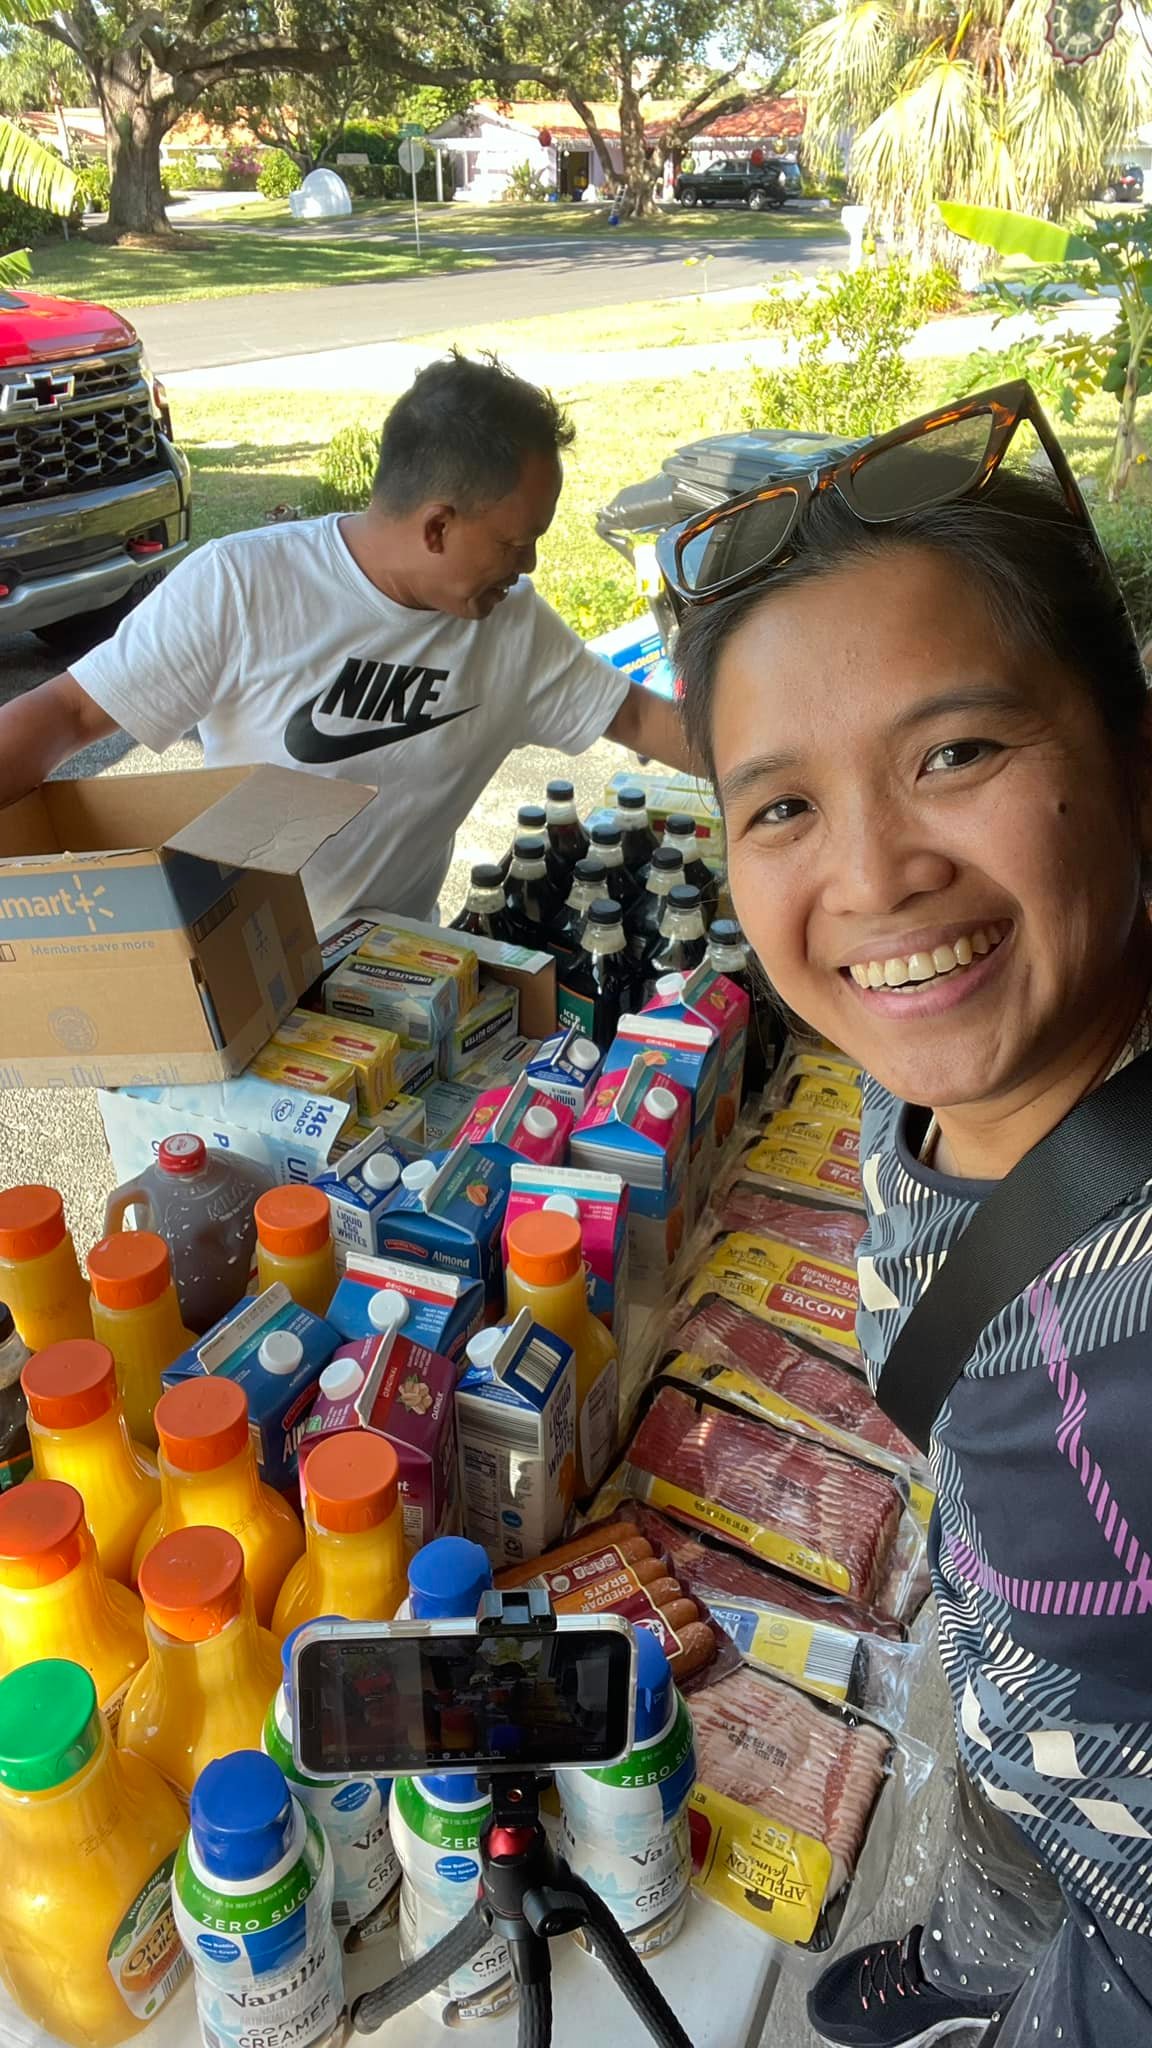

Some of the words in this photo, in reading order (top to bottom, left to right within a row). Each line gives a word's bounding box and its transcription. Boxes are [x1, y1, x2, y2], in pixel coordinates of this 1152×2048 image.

[318, 657, 451, 724] NIKE
[31, 942, 89, 955] Members
[92, 944, 119, 953] save
[122, 940, 155, 950] more
[354, 964, 388, 976] BUTTER
[388, 970, 432, 983] UNSALTED
[563, 1008, 581, 1022] ICED
[292, 1100, 318, 1135] LOADS
[305, 1104, 334, 1138] 146
[336, 1209, 363, 1229] LIQUID
[343, 1219, 359, 1236] EGG
[336, 1227, 367, 1248] WHITES
[431, 1250, 470, 1270] Almond
[800, 1265, 842, 1286] PREMIUM
[802, 1275, 859, 1302] BACON
[781, 1291, 847, 1320] BACON
[383, 1366, 398, 1398] ORIGINAL
[431, 1391, 445, 1421] OATMILK
[581, 1583, 633, 1613] CHEDDAR
[584, 1573, 629, 1600] BRATS
[621, 1765, 670, 1787] ZERO
[725, 1852, 807, 1902] APPLETON
[747, 1855, 789, 1886] farms
[127, 1889, 148, 1920] HIGH
[147, 1867, 166, 1892] PULP
[201, 1913, 260, 1932] ZERO
[225, 1947, 327, 2008] Vanilla
[238, 1992, 331, 2048] CREAMER
